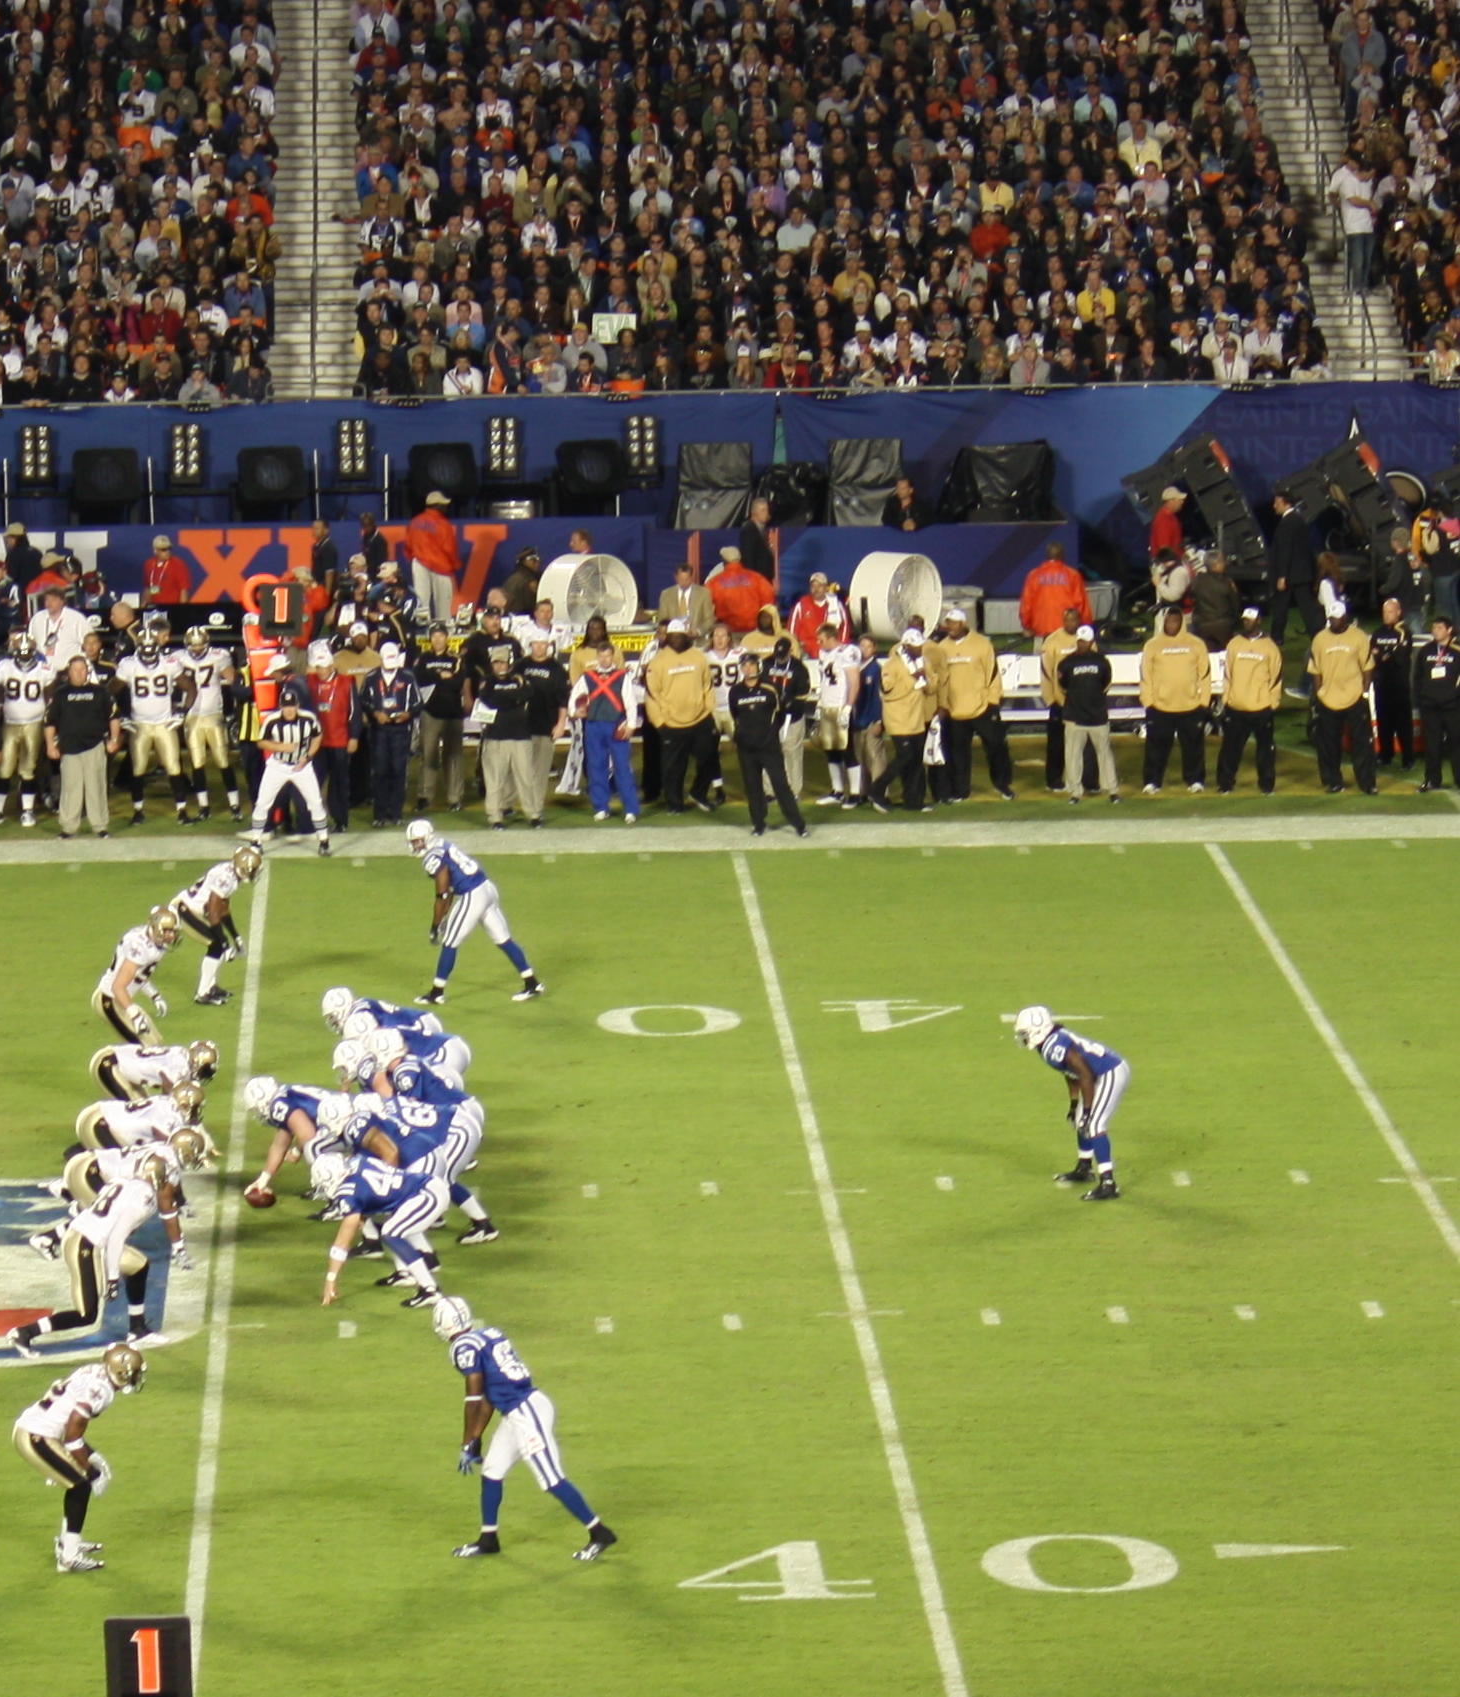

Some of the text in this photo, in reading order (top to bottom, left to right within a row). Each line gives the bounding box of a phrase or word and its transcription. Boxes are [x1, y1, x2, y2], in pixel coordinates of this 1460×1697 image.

[1216, 399, 1336, 428] SAINTS
[1226, 434, 1328, 465] AINTS
[272, 587, 289, 624] 1
[6, 677, 41, 701] 90
[134, 675, 170, 698] 69
[456, 1349, 476, 1370] 87
[129, 1627, 161, 1694] 1
